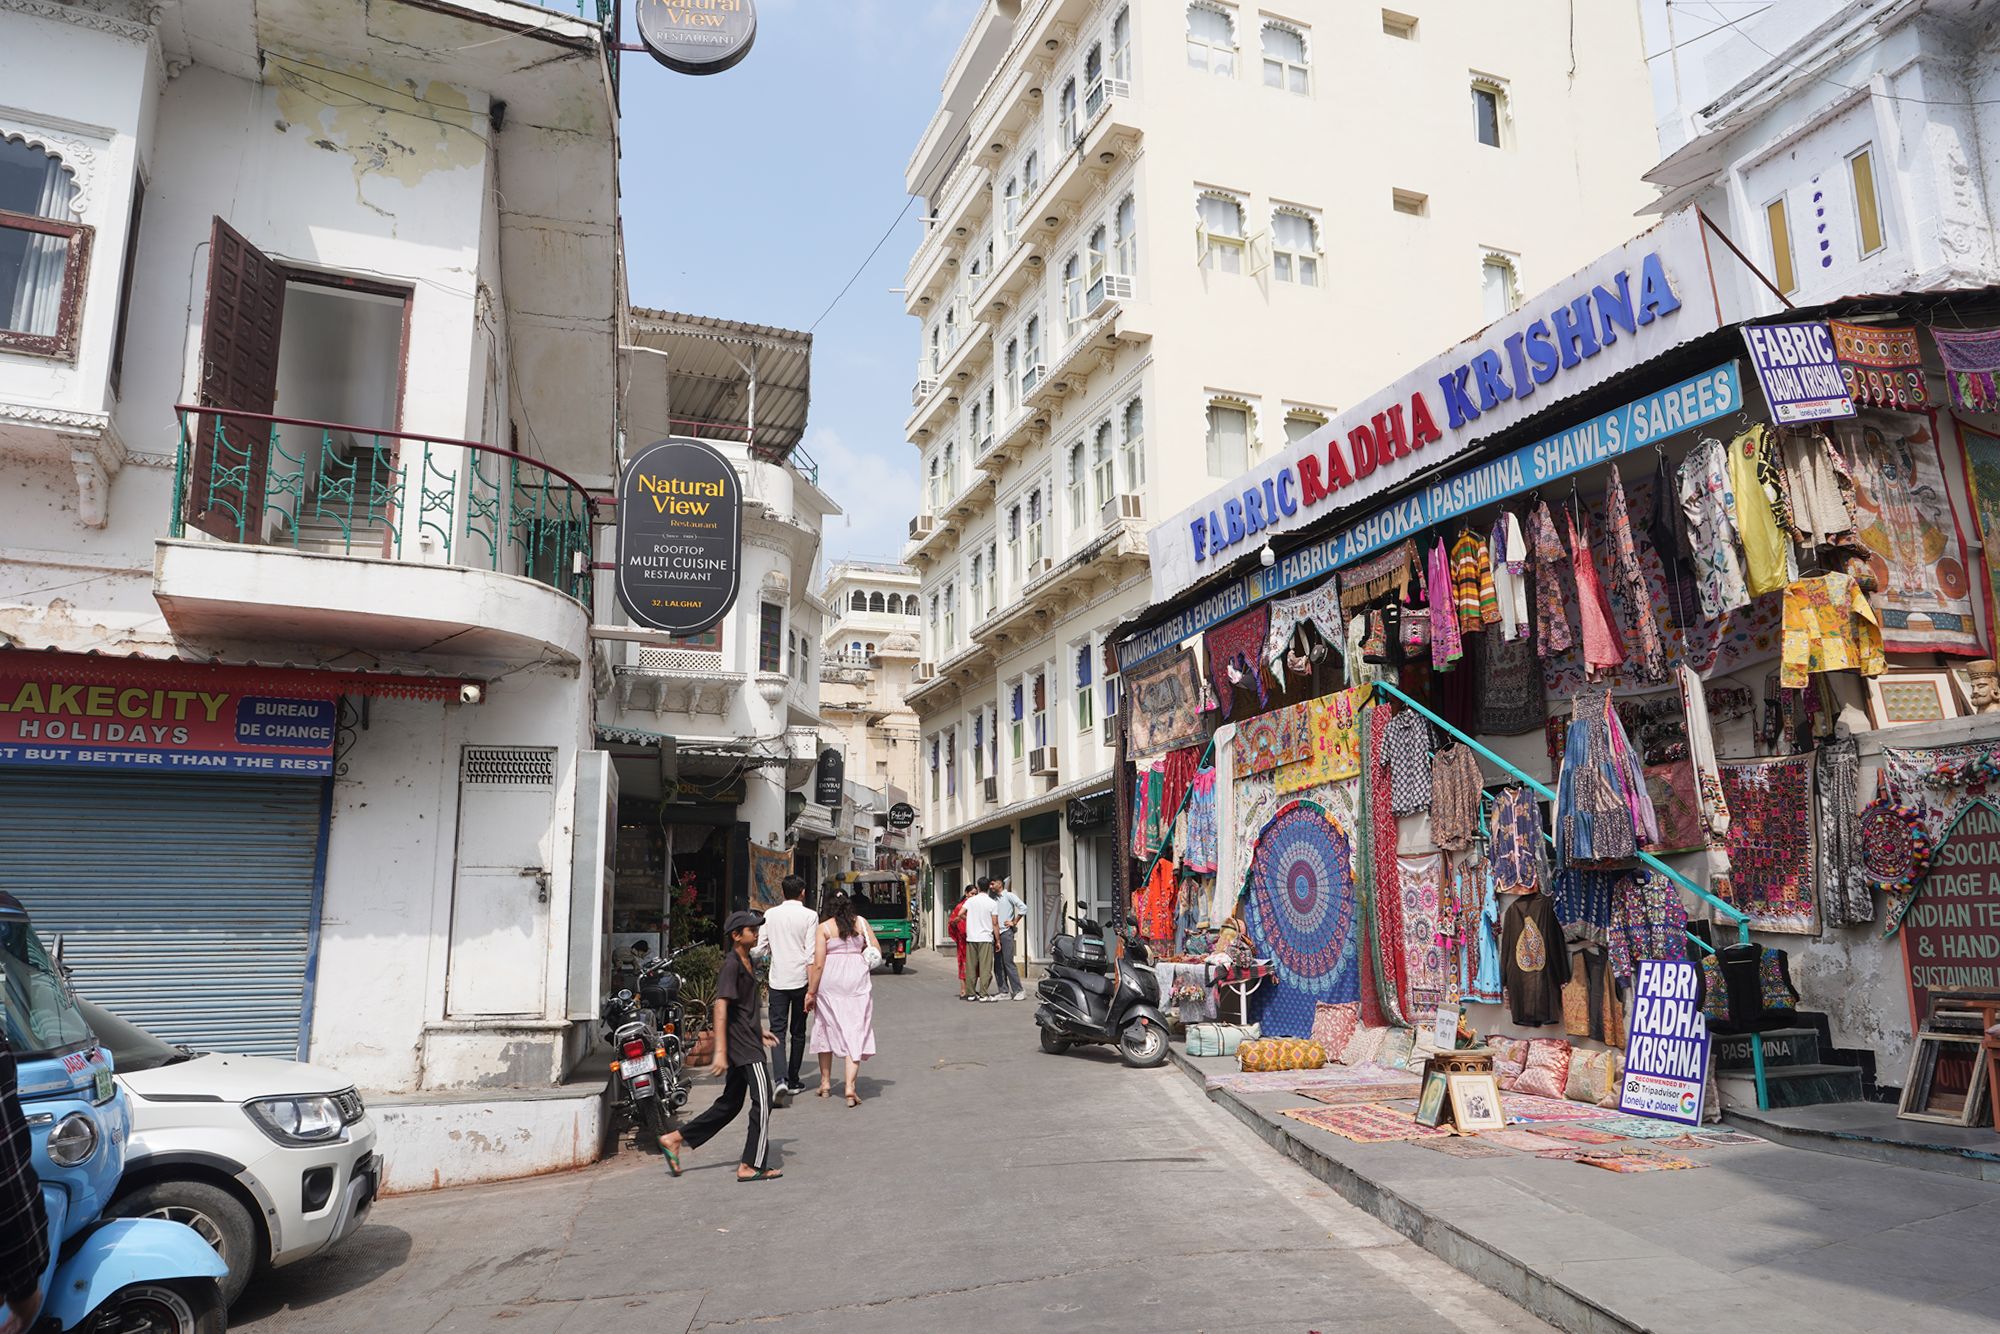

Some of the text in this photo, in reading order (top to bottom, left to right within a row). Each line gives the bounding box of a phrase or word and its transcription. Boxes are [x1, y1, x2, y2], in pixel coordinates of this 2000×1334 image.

[667, 8, 725, 27] View
[657, 32, 735, 44] RESTAURANT
[1750, 325, 1833, 367] FABRIC
[1765, 364, 1847, 402] RADHA KRISHNA
[1190, 251, 1683, 563] FABRIC RADHA KRISHNA
[638, 474, 725, 497] Natural
[652, 495, 710, 516] View
[670, 520, 718, 529] Restaurant
[653, 544, 705, 555] ROOFTOP
[630, 556, 727, 570] MULTI CUISINE
[1121, 621, 1185, 667] MANUFACTURER
[1186, 615, 1193, 633] &
[1194, 585, 1244, 627] EXPORTER
[1281, 540, 1339, 584] FABRIC
[1344, 502, 1425, 564] ASHOKA
[1433, 455, 1525, 517] PASHMINA
[644, 570, 712, 581] RESTAURANT
[665, 600, 703, 608] LALGHAT
[255, 703, 319, 718] BUREAU
[19, 720, 190, 744] HOLIDAYS
[240, 723, 330, 740] DE CHANGE
[25, 749, 71, 761] BUT
[77, 750, 163, 765] BETTER
[170, 754, 227, 767] THAN
[234, 756, 273, 769] THE
[280, 758, 332, 771] REST
[1918, 935, 1936, 958] &
[1637, 962, 1698, 999] FABRI
[1633, 997, 1706, 1040] RADHA
[1628, 1035, 1700, 1079] KRISHNA
[1635, 1076, 1678, 1087] RECOMMENDED
[1642, 1085, 1680, 1099] Tripadvisor
[1624, 1094, 1678, 1113] lonely planet
